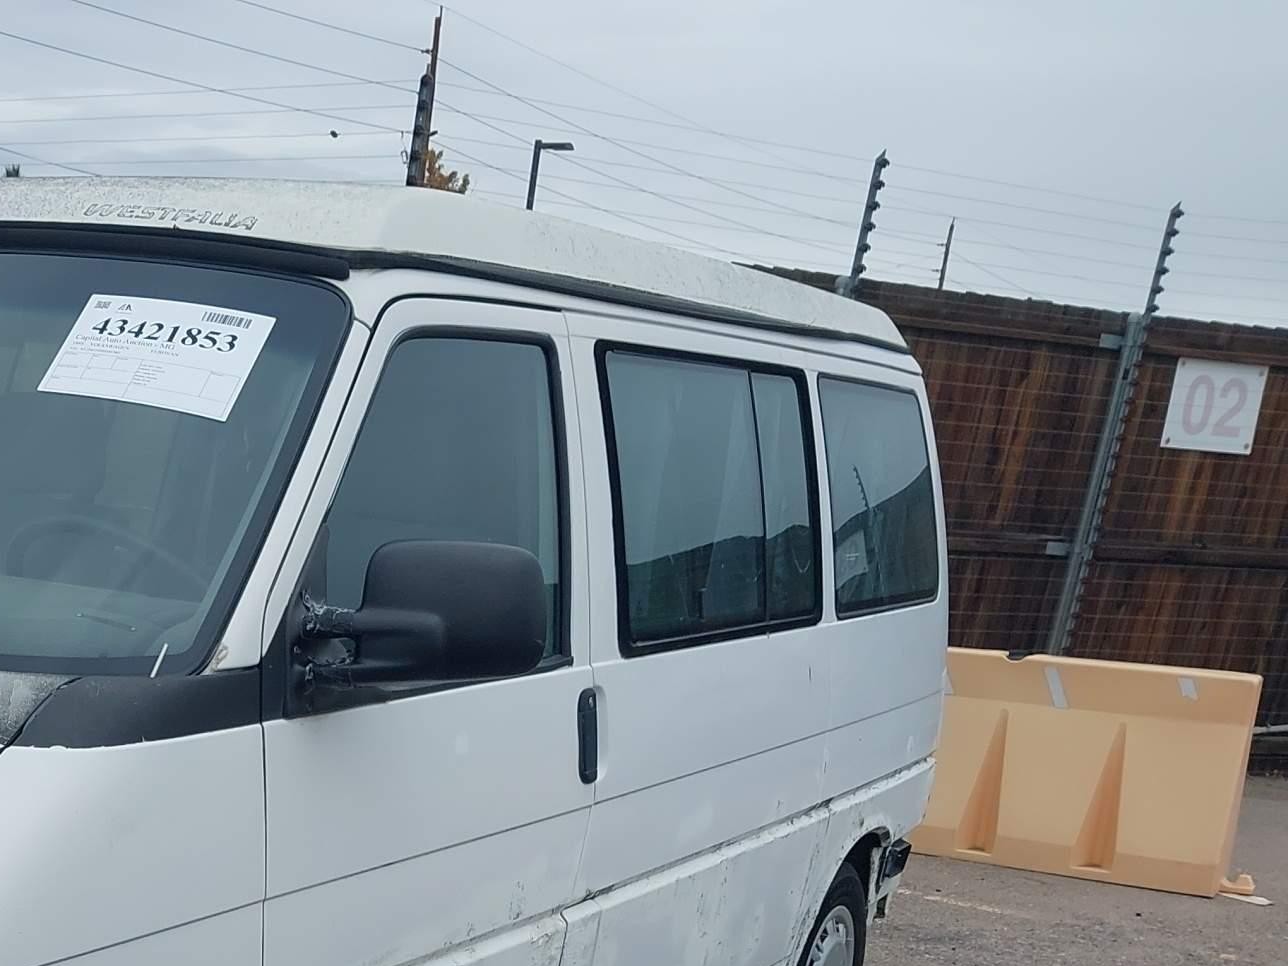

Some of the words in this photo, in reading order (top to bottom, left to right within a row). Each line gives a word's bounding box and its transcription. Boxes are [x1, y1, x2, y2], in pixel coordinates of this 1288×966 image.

[83, 203, 259, 231] WESTFALIA
[75, 334, 103, 342] Capital
[103, 335, 122, 344] Auto
[122, 337, 153, 348] Auction
[92, 317, 239, 353] 43421853
[1181, 373, 1249, 438] 02
